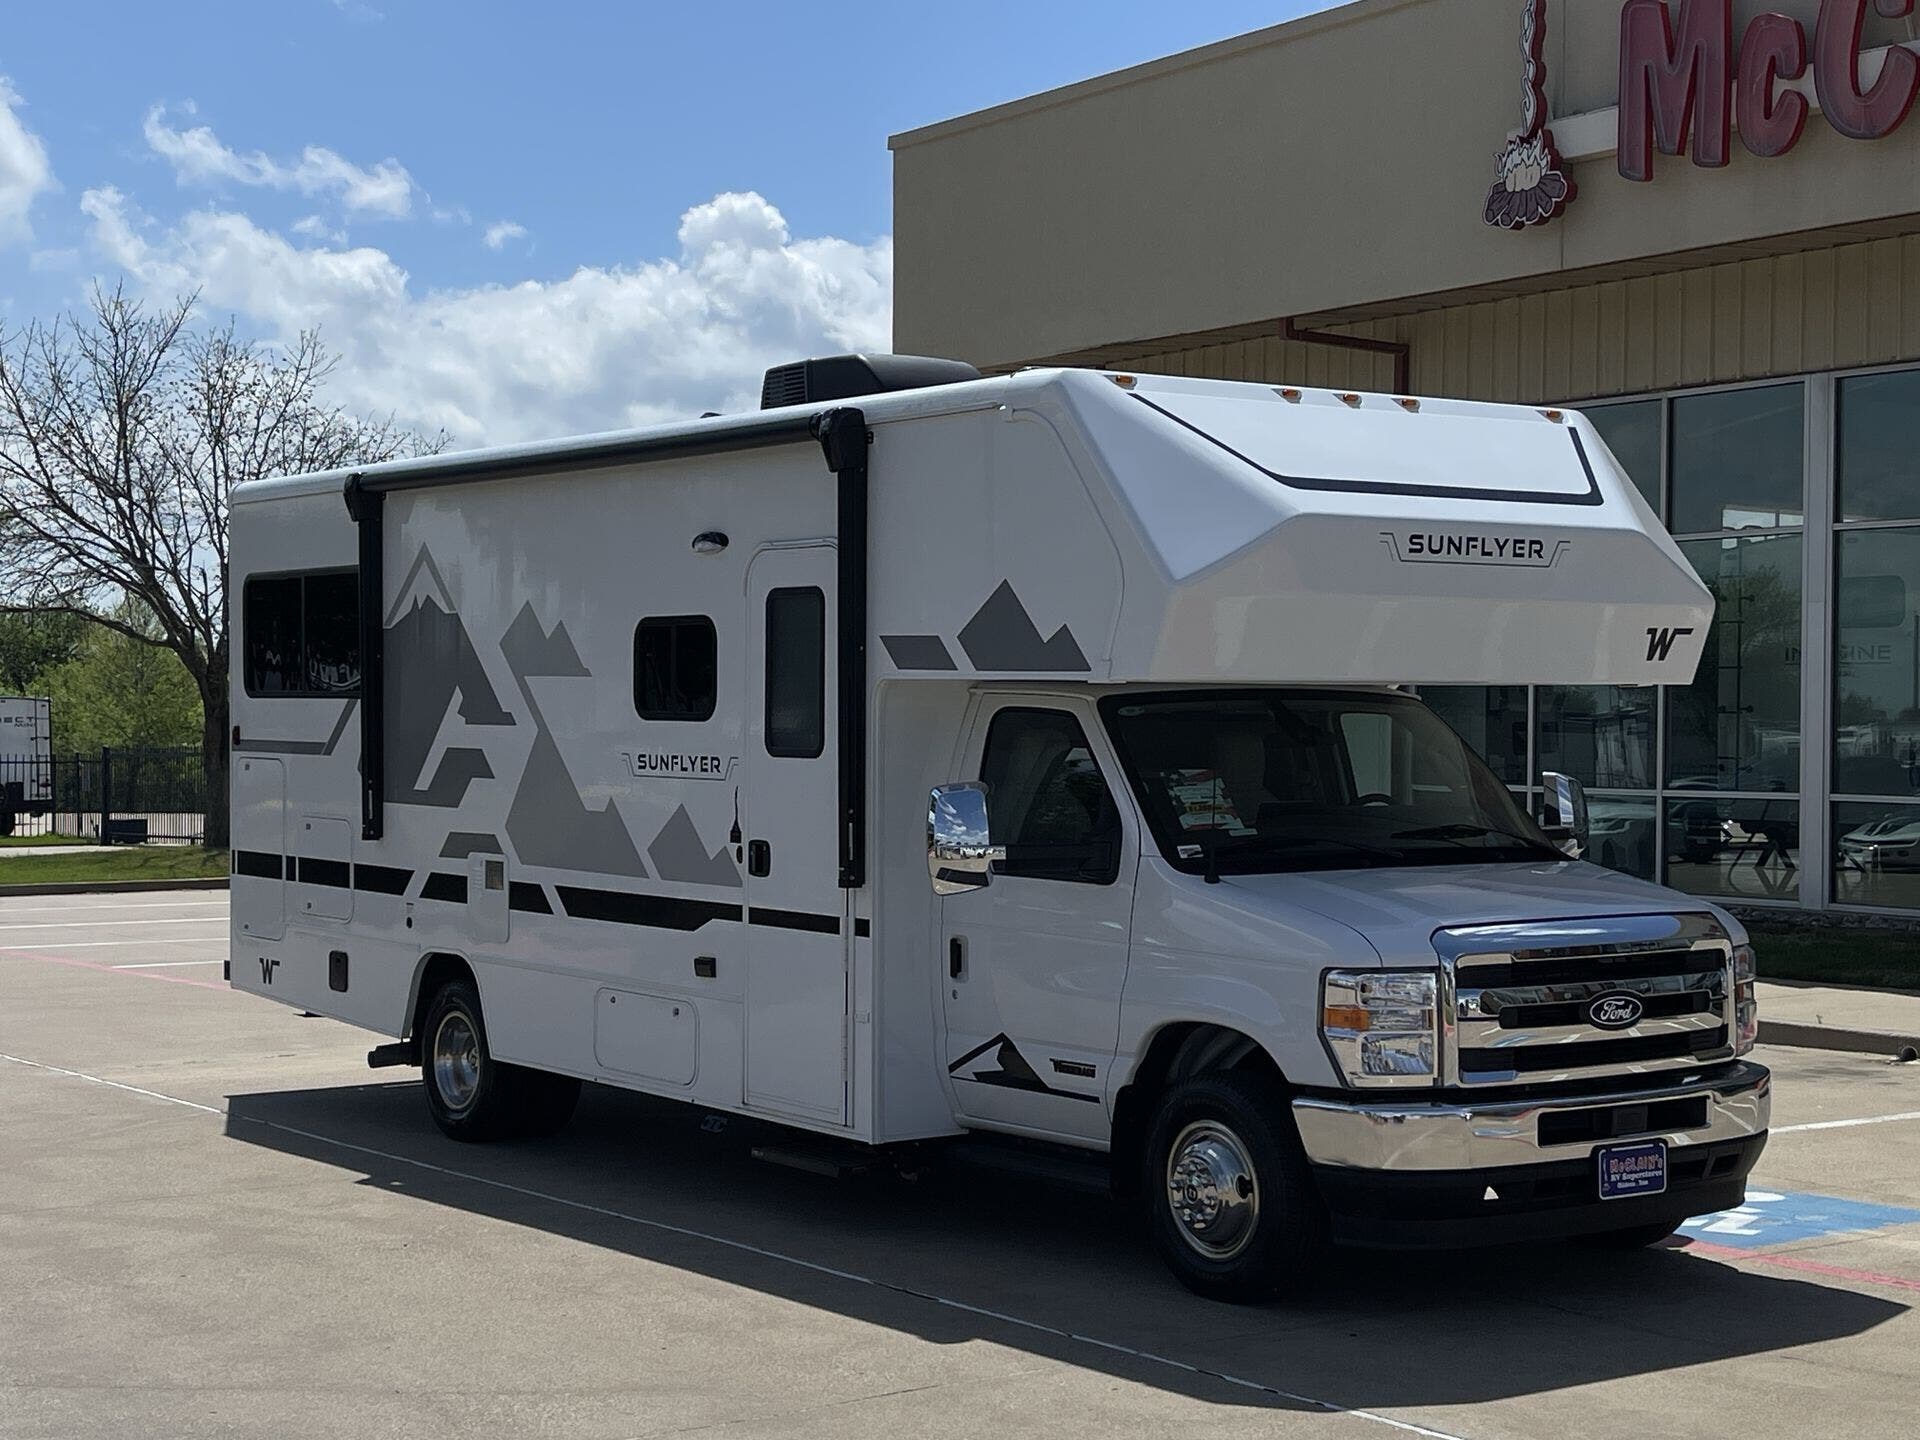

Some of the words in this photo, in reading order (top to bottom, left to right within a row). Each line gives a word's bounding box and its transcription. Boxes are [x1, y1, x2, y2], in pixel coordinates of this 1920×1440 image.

[1408, 534, 1544, 559] SUNFLYER
[637, 753, 721, 773] SUNFLYER
[1600, 1000, 1633, 1020] Ford
